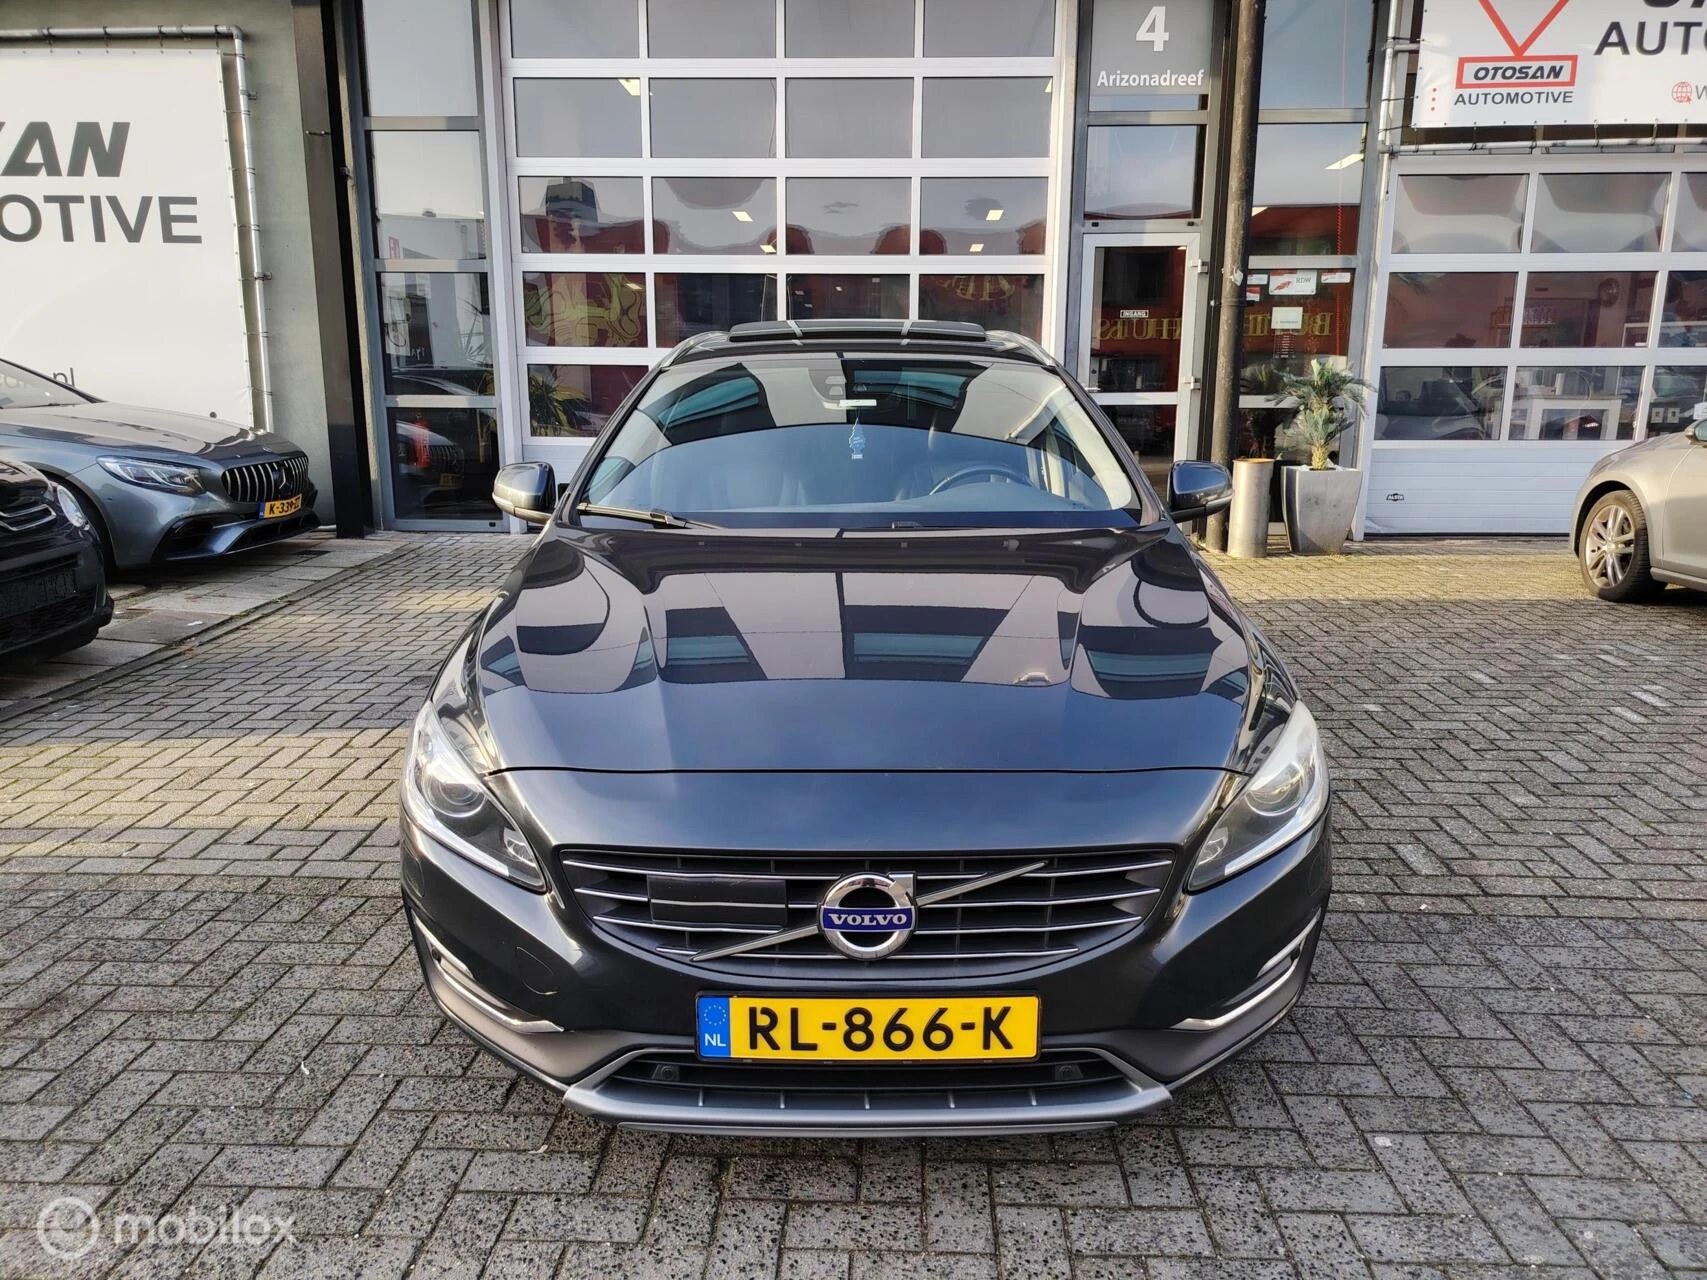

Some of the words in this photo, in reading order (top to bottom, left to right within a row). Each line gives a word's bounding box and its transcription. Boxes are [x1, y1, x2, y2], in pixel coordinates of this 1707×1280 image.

[1136, 6, 1169, 51] 4
[1593, 21, 1707, 56] AUT
[1097, 69, 1205, 87] Arizonadreef
[1473, 65, 1564, 81] OTOSAN
[1454, 91, 1574, 106] AUTOMOTIVE
[0, 121, 131, 178] AN
[828, 912, 908, 926] VOLVO
[748, 1006, 1014, 1052] RL-866-K
[704, 1034, 727, 1048] NL
